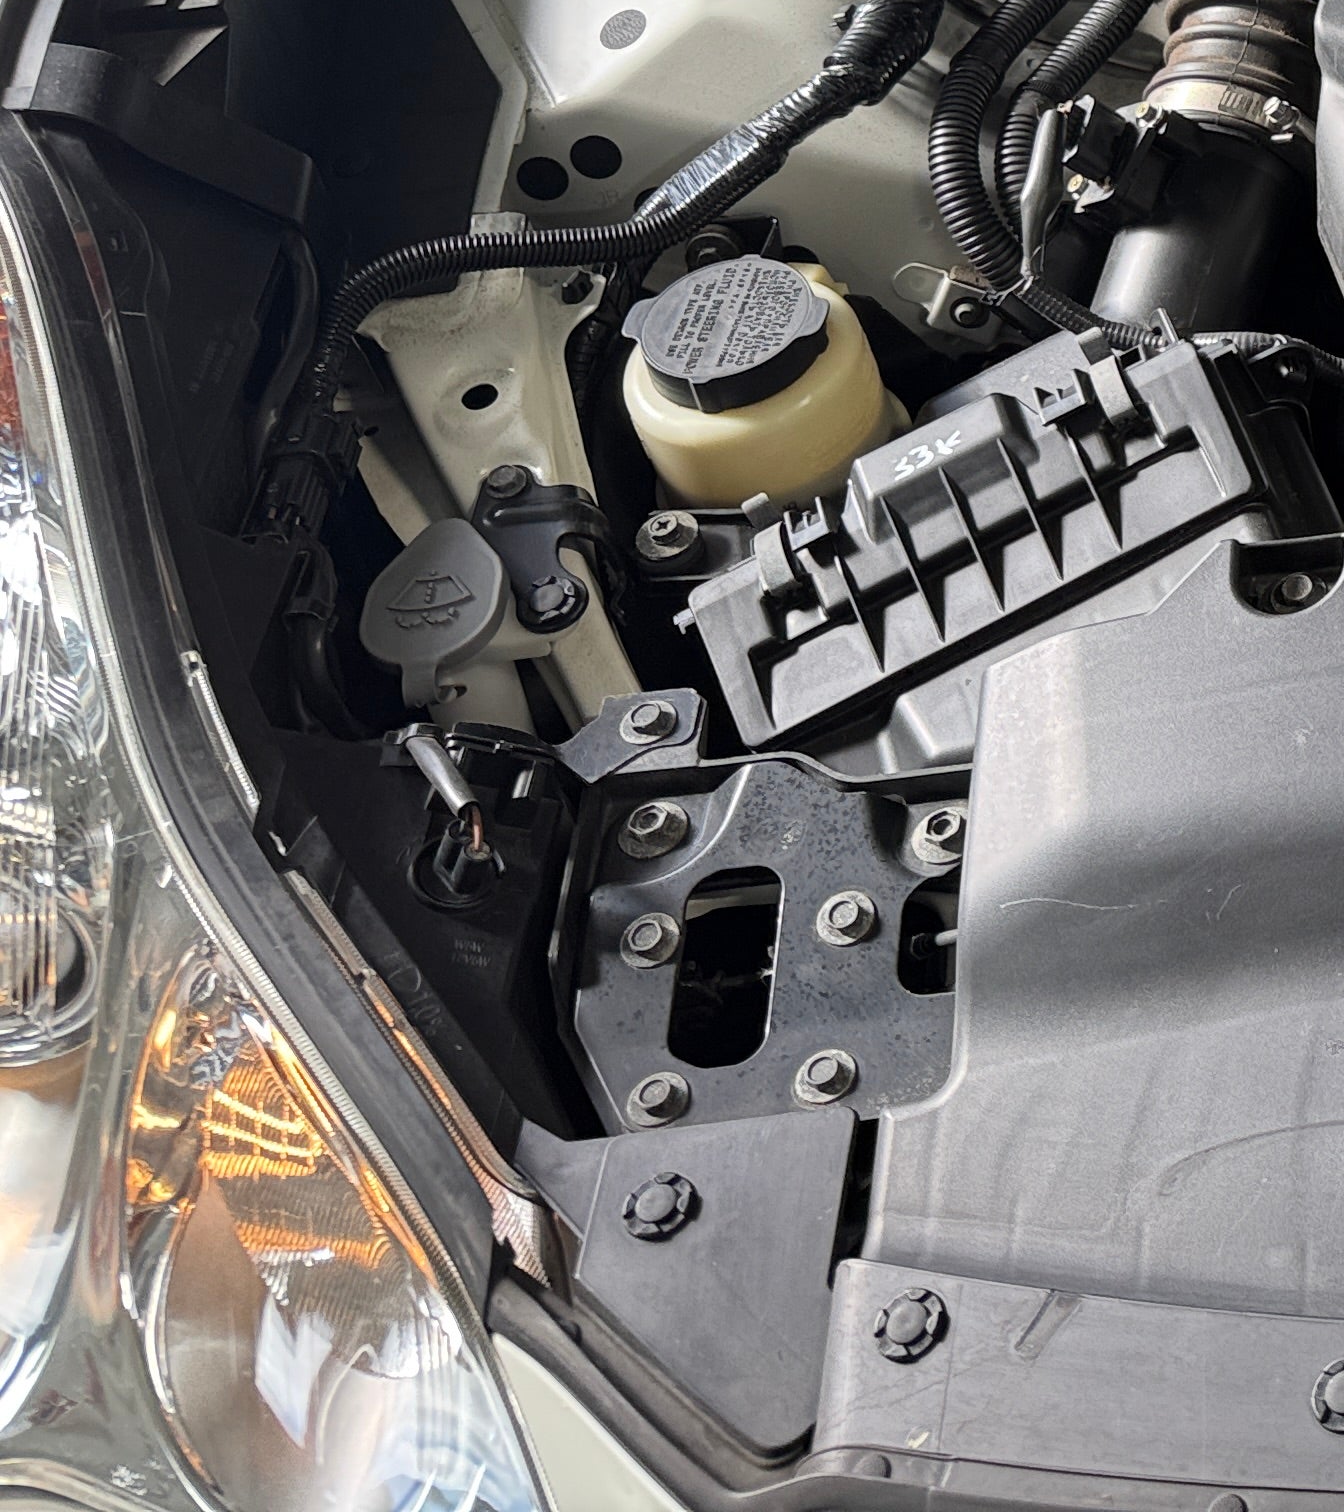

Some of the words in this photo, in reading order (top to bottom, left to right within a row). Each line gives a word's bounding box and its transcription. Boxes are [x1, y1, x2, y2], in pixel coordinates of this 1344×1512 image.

[676, 343, 691, 359] FILL
[684, 330, 696, 340] TO
[682, 347, 705, 375] POWER
[697, 299, 725, 343] STEERING
